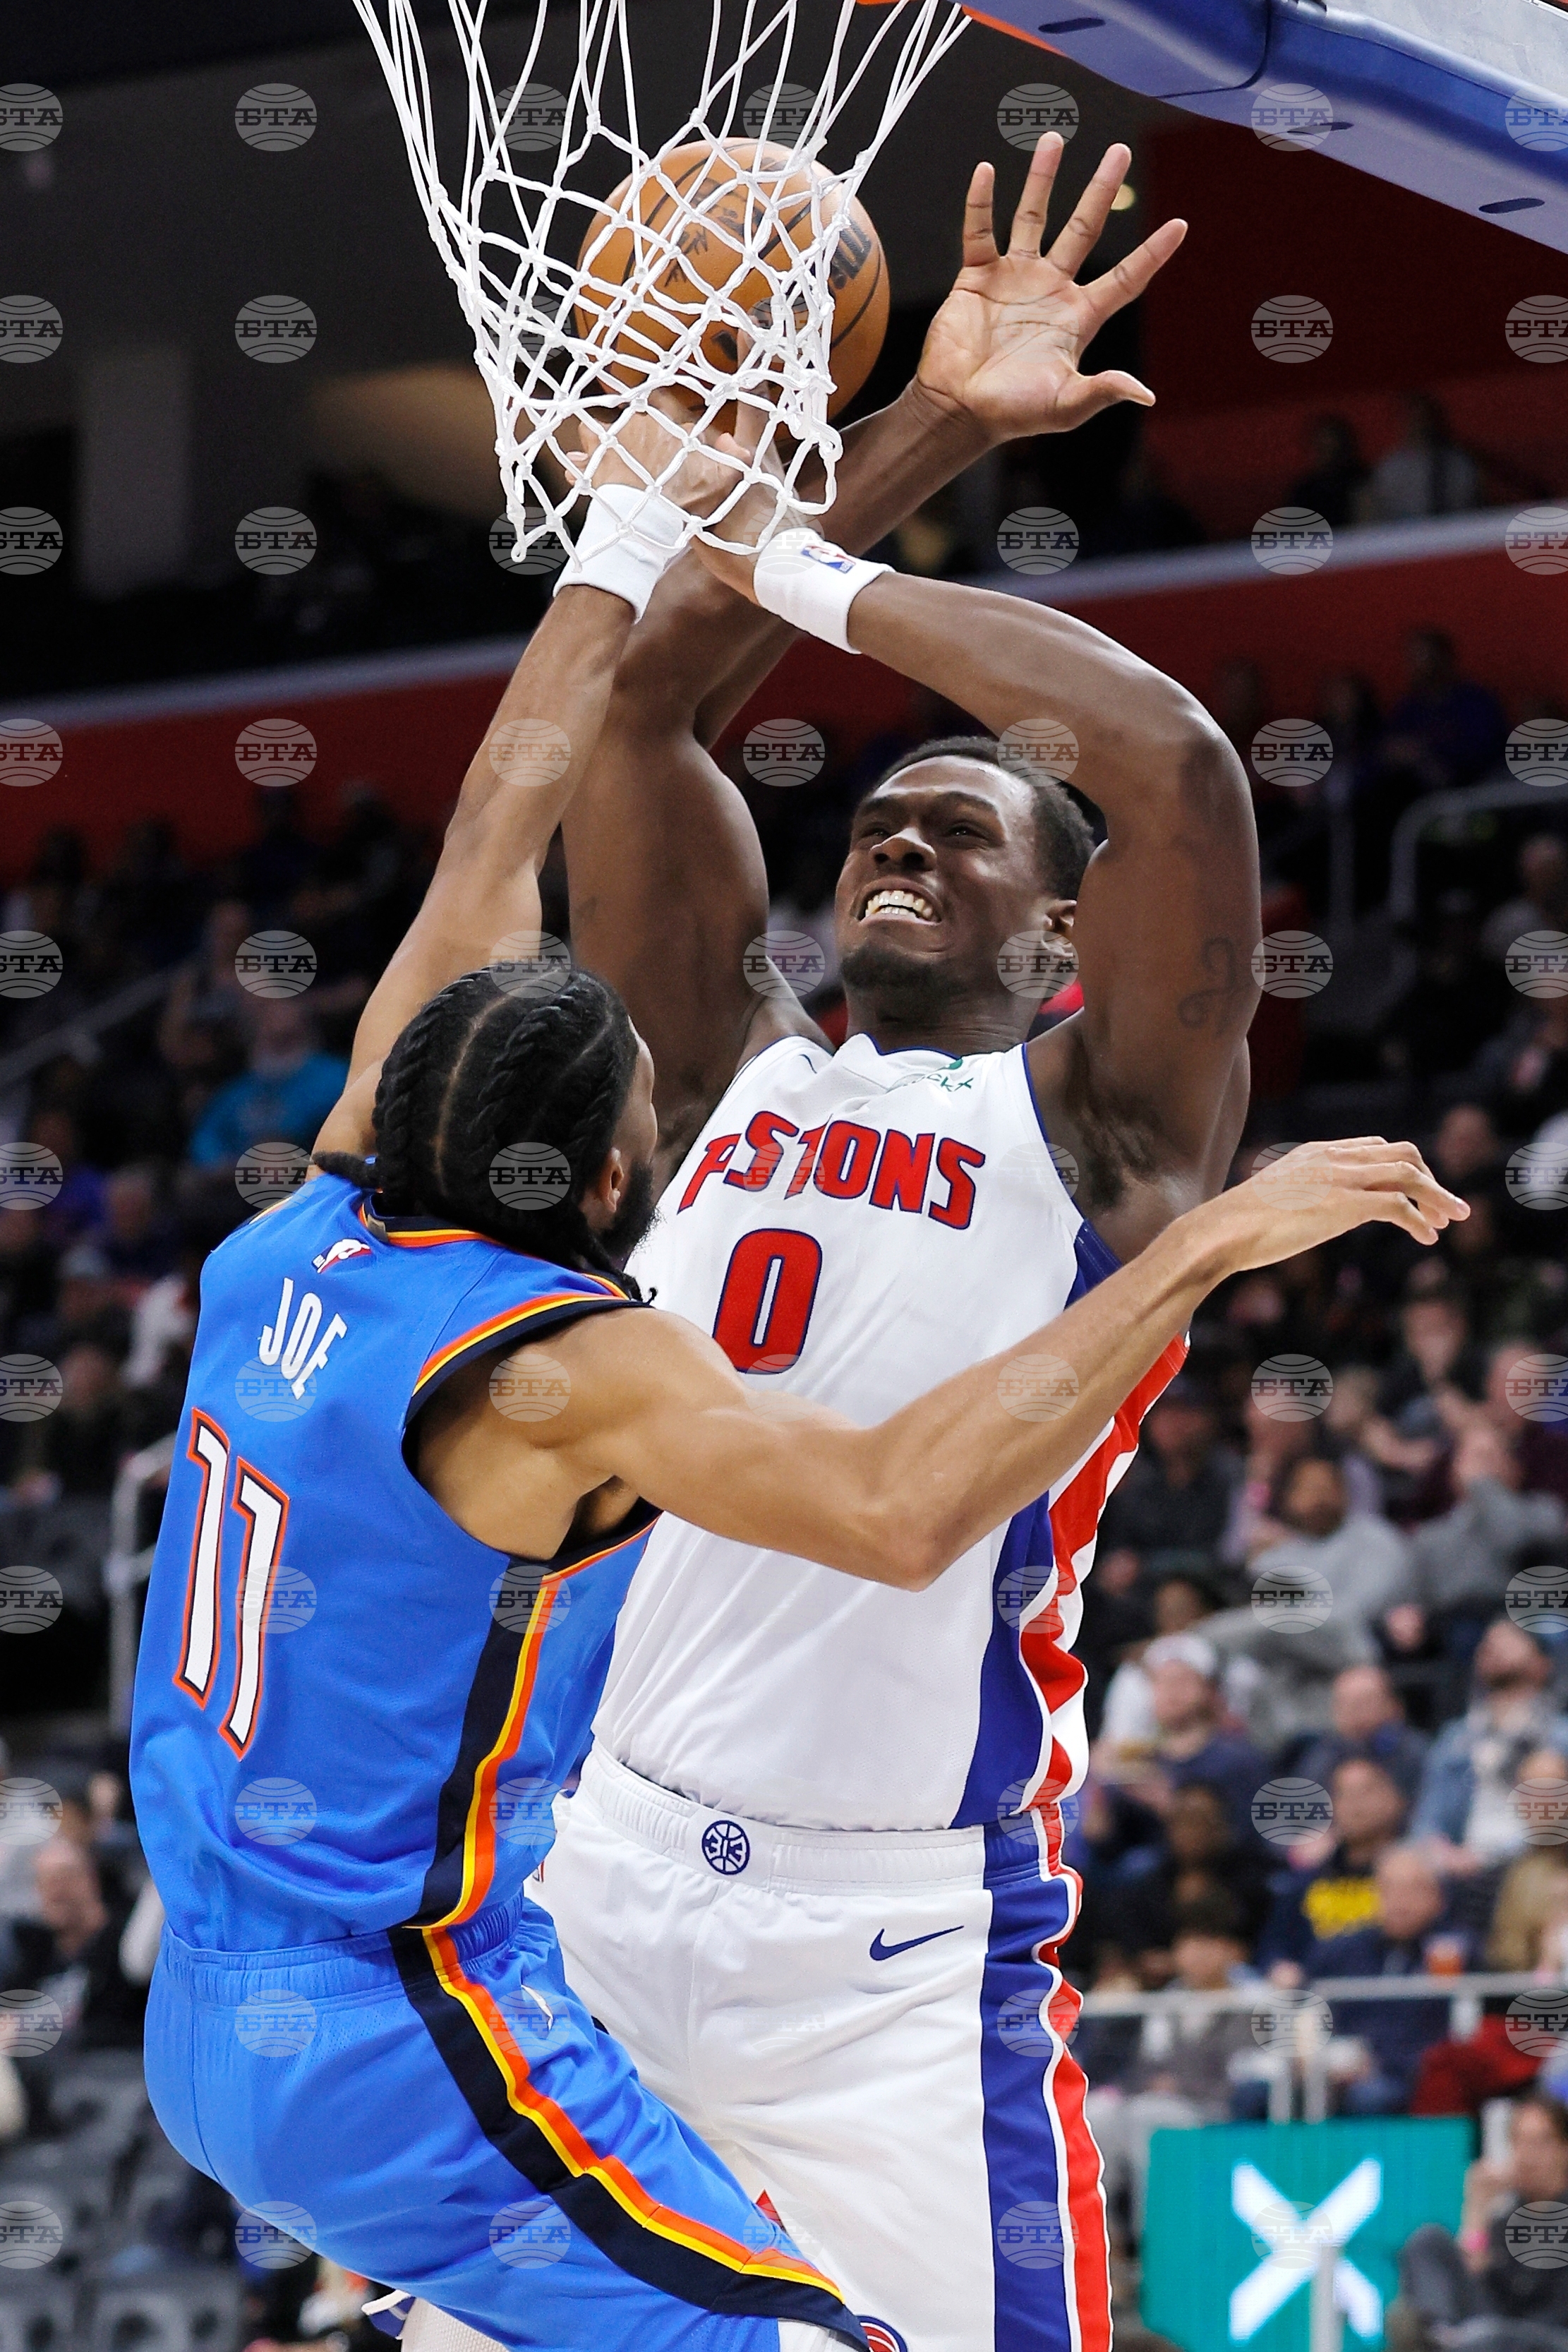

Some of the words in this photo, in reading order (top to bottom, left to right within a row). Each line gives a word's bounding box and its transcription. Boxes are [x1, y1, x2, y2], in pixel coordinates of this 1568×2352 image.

[677, 1110, 986, 1230] PSTONS
[259, 1277, 347, 1400] JOE
[712, 1228, 822, 1374] 0
[173, 1407, 290, 1762] 11
